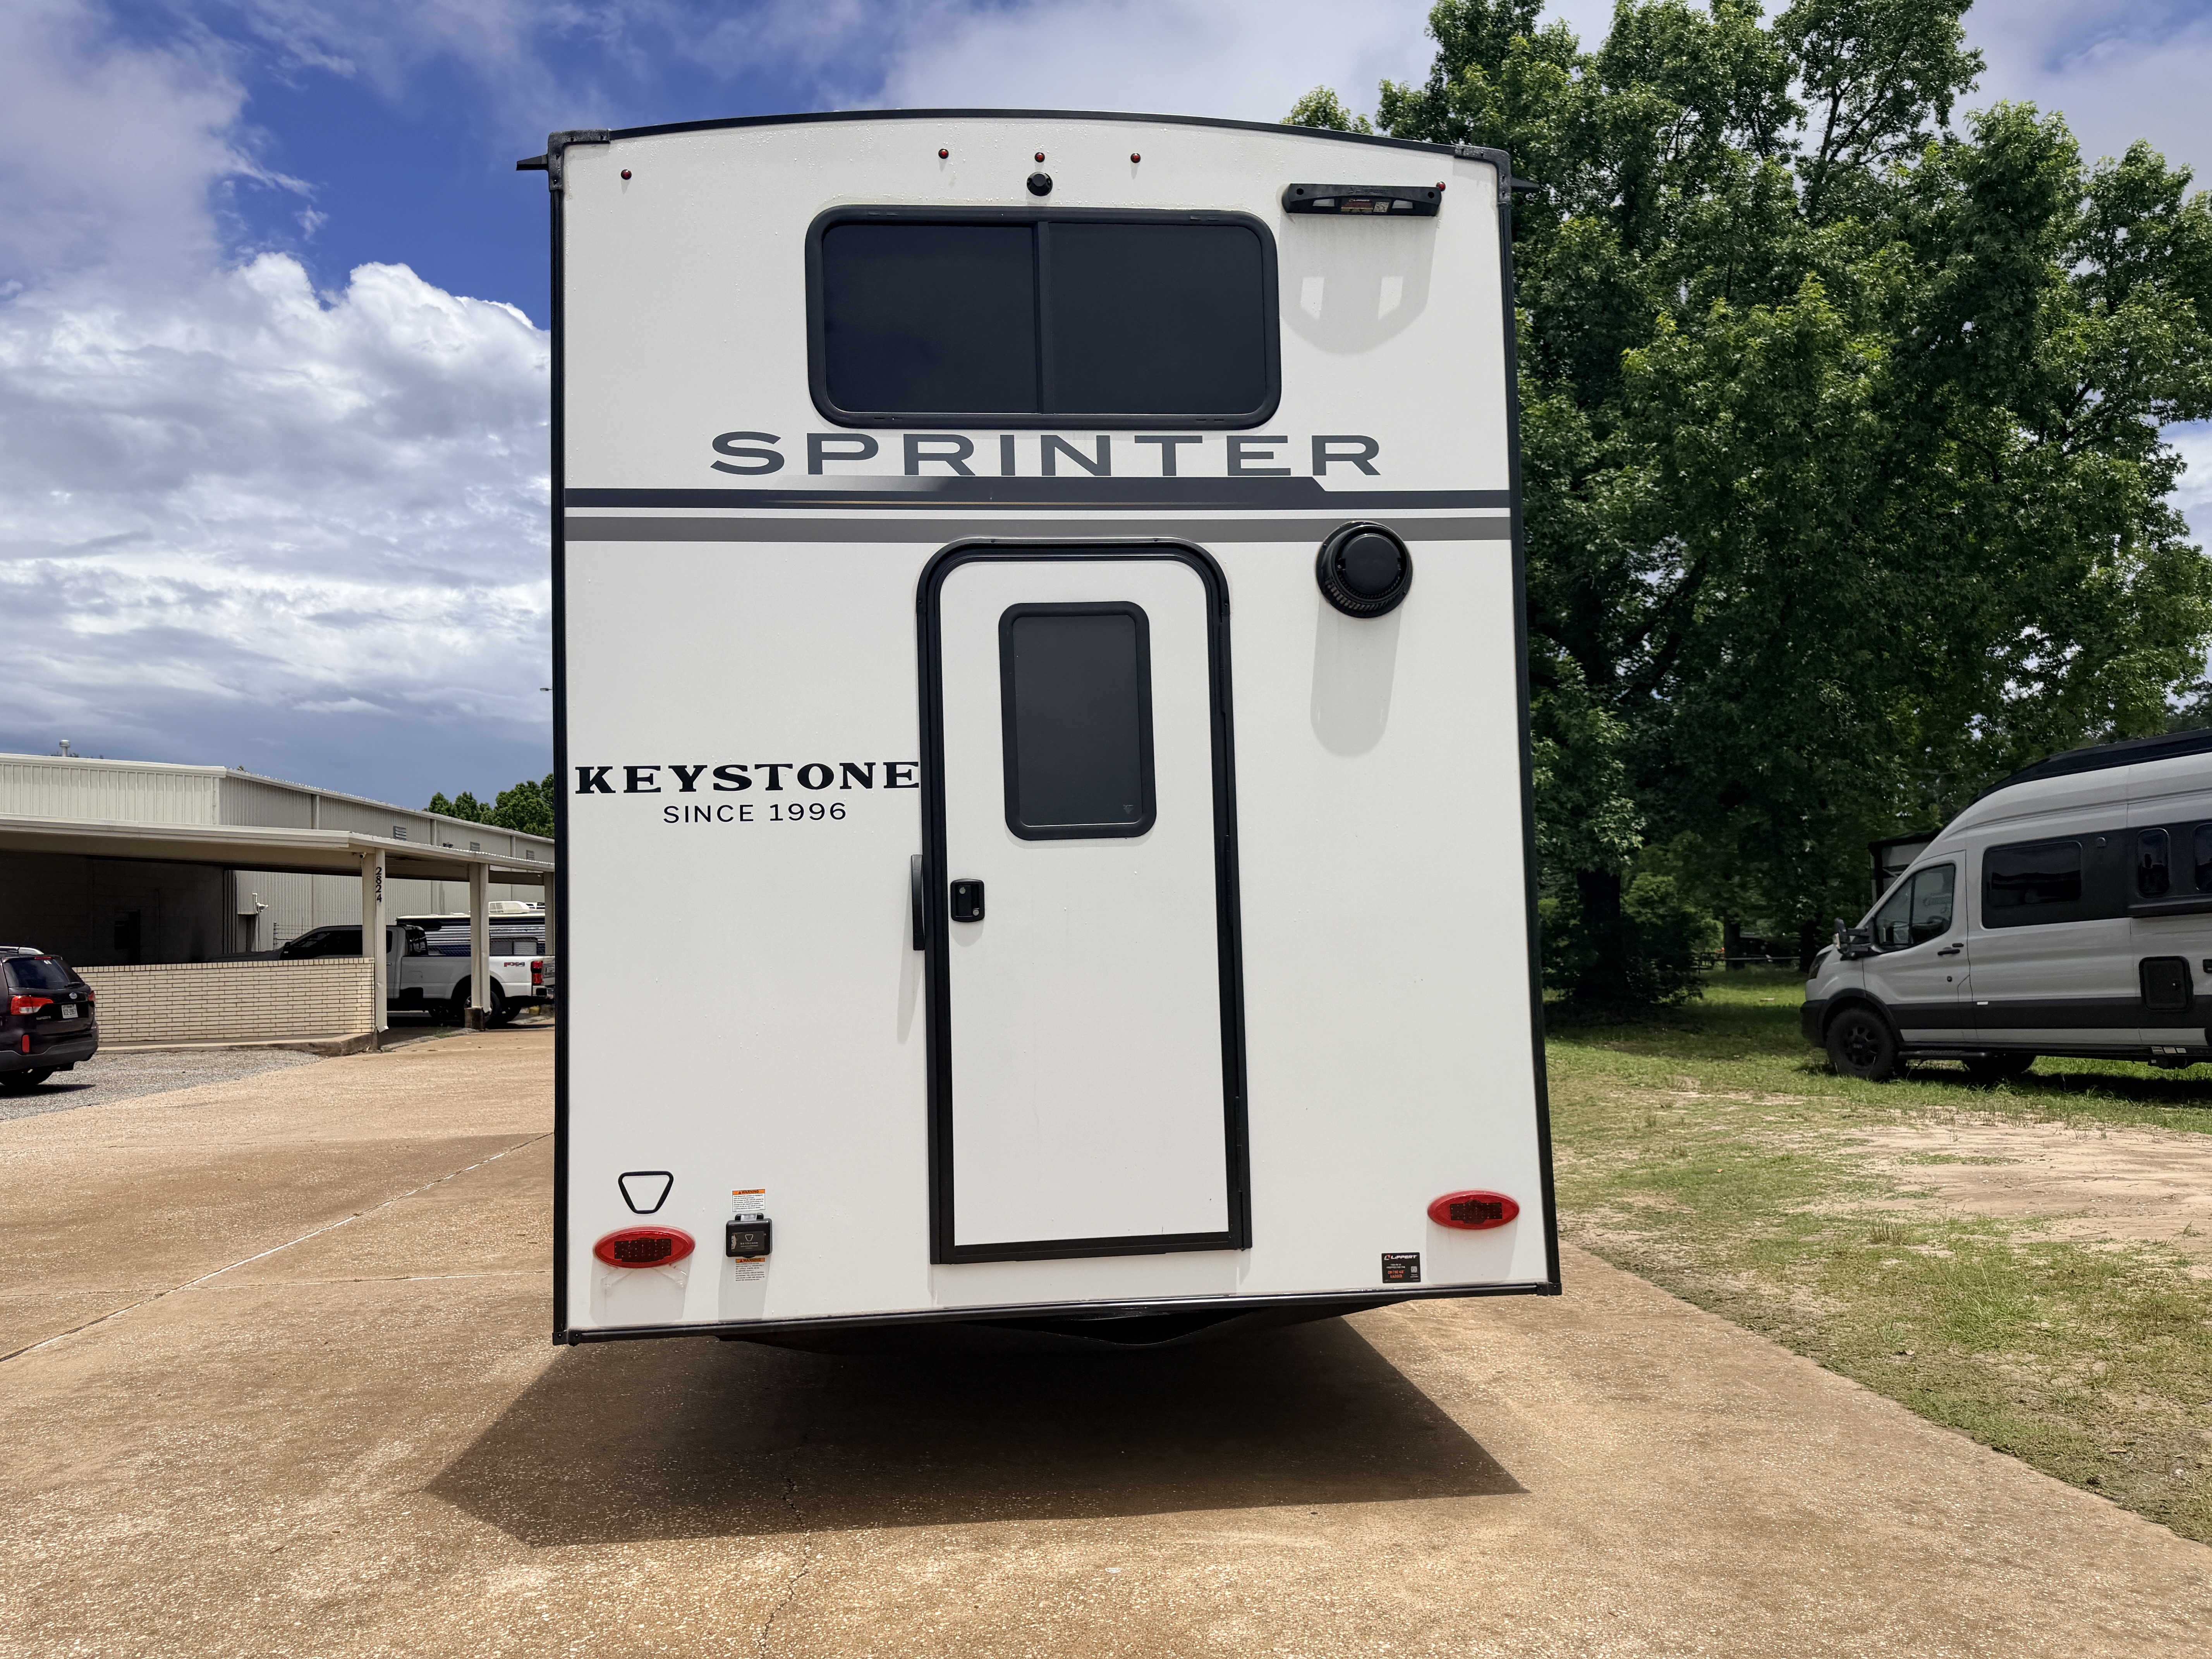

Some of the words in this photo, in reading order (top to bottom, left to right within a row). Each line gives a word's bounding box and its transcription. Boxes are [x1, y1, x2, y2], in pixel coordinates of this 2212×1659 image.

[711, 431, 1381, 476] SPRINTER
[575, 761, 919, 794] KEYSTONE
[663, 804, 754, 824] SINCE
[770, 802, 847, 821] 1996
